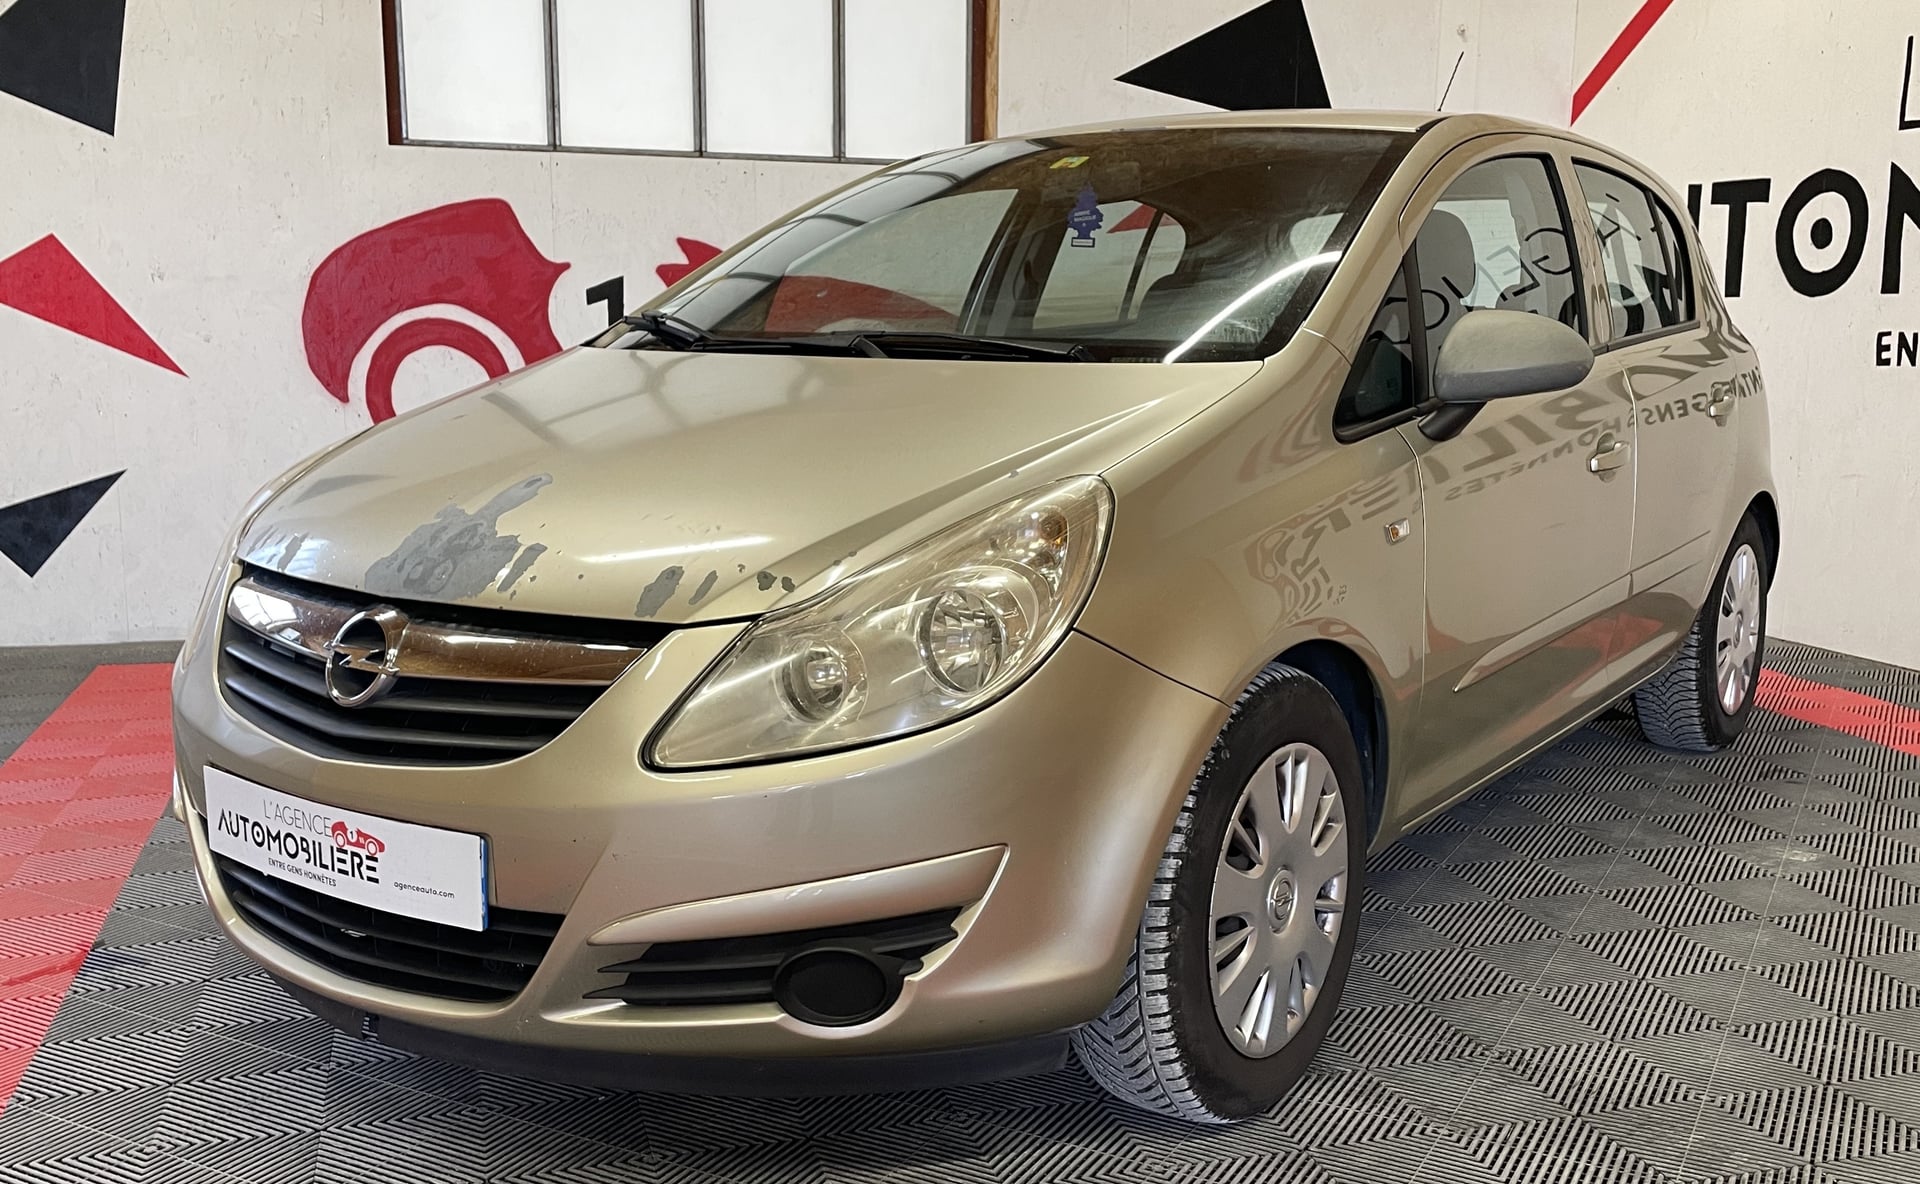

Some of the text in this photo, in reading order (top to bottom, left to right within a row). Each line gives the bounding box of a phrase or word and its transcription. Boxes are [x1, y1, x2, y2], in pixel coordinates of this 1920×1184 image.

[263, 799, 332, 838] L'AGENCE
[268, 857, 286, 871] ENTRE
[287, 864, 303, 877] GENS
[393, 881, 455, 899] agenceauto.com
